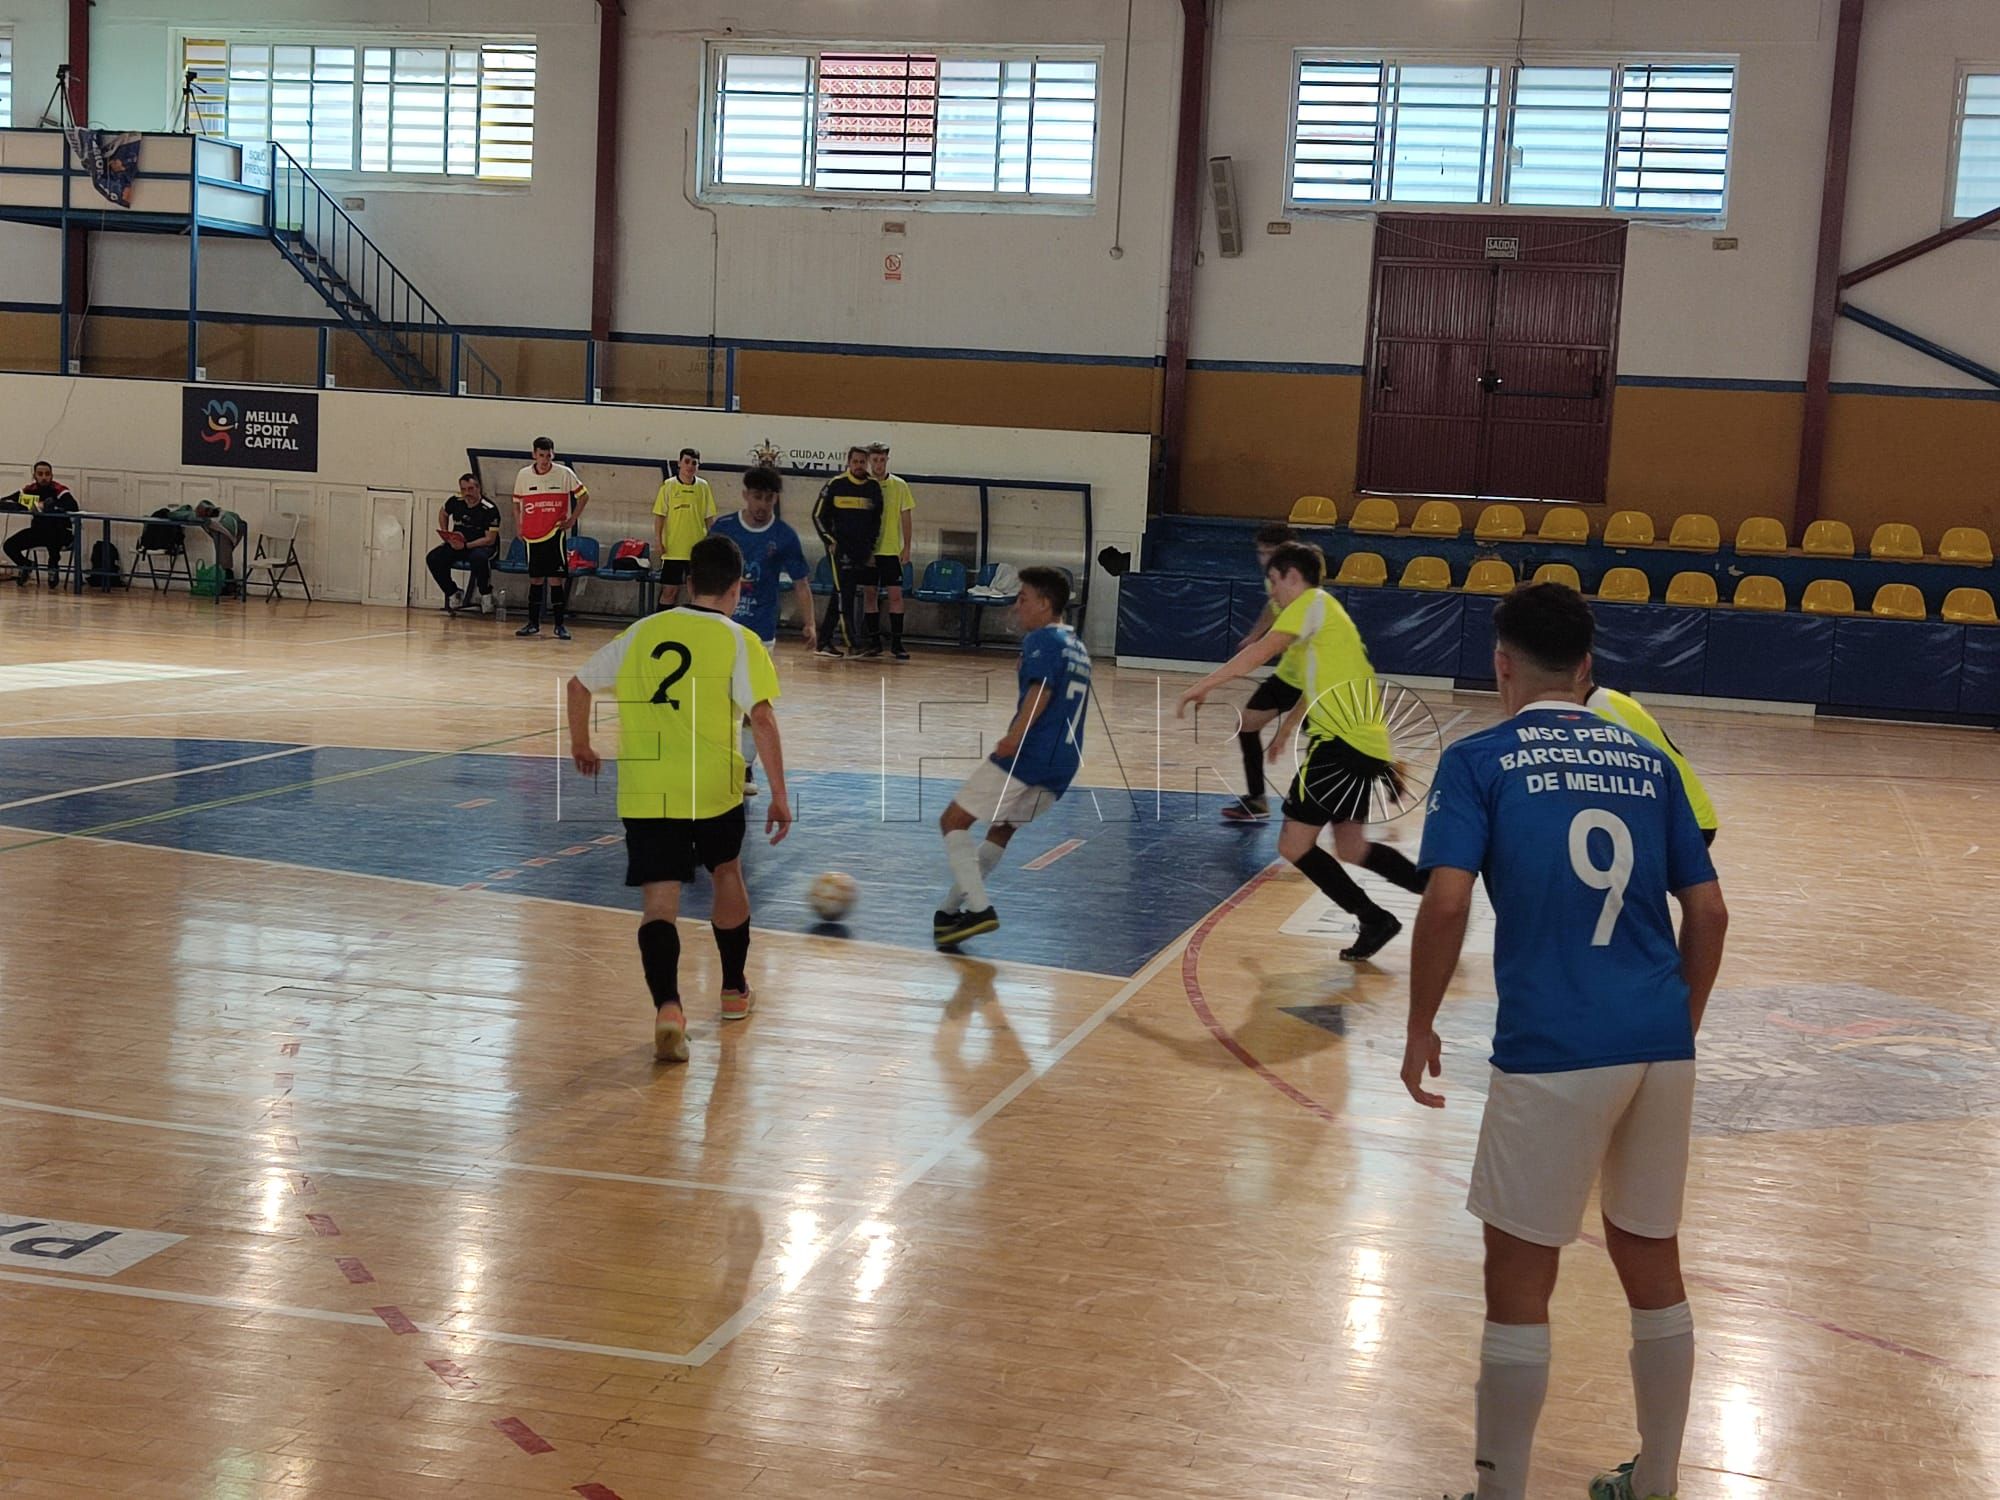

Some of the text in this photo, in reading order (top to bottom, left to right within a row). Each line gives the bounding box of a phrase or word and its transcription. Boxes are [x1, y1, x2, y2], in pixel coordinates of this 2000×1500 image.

[245, 410, 299, 424] MELILLA
[245, 424, 289, 437] SPORT
[245, 437, 299, 450] CAPITAL
[789, 449, 825, 460] CIUDAD
[650, 641, 692, 711] 2
[1066, 680, 1088, 744] 7
[1515, 725, 1637, 746] MSC PEÑA
[1500, 748, 1664, 778] BARCELONISTA
[1526, 772, 1656, 798] DE MELILLA
[1568, 808, 1635, 947] 9
